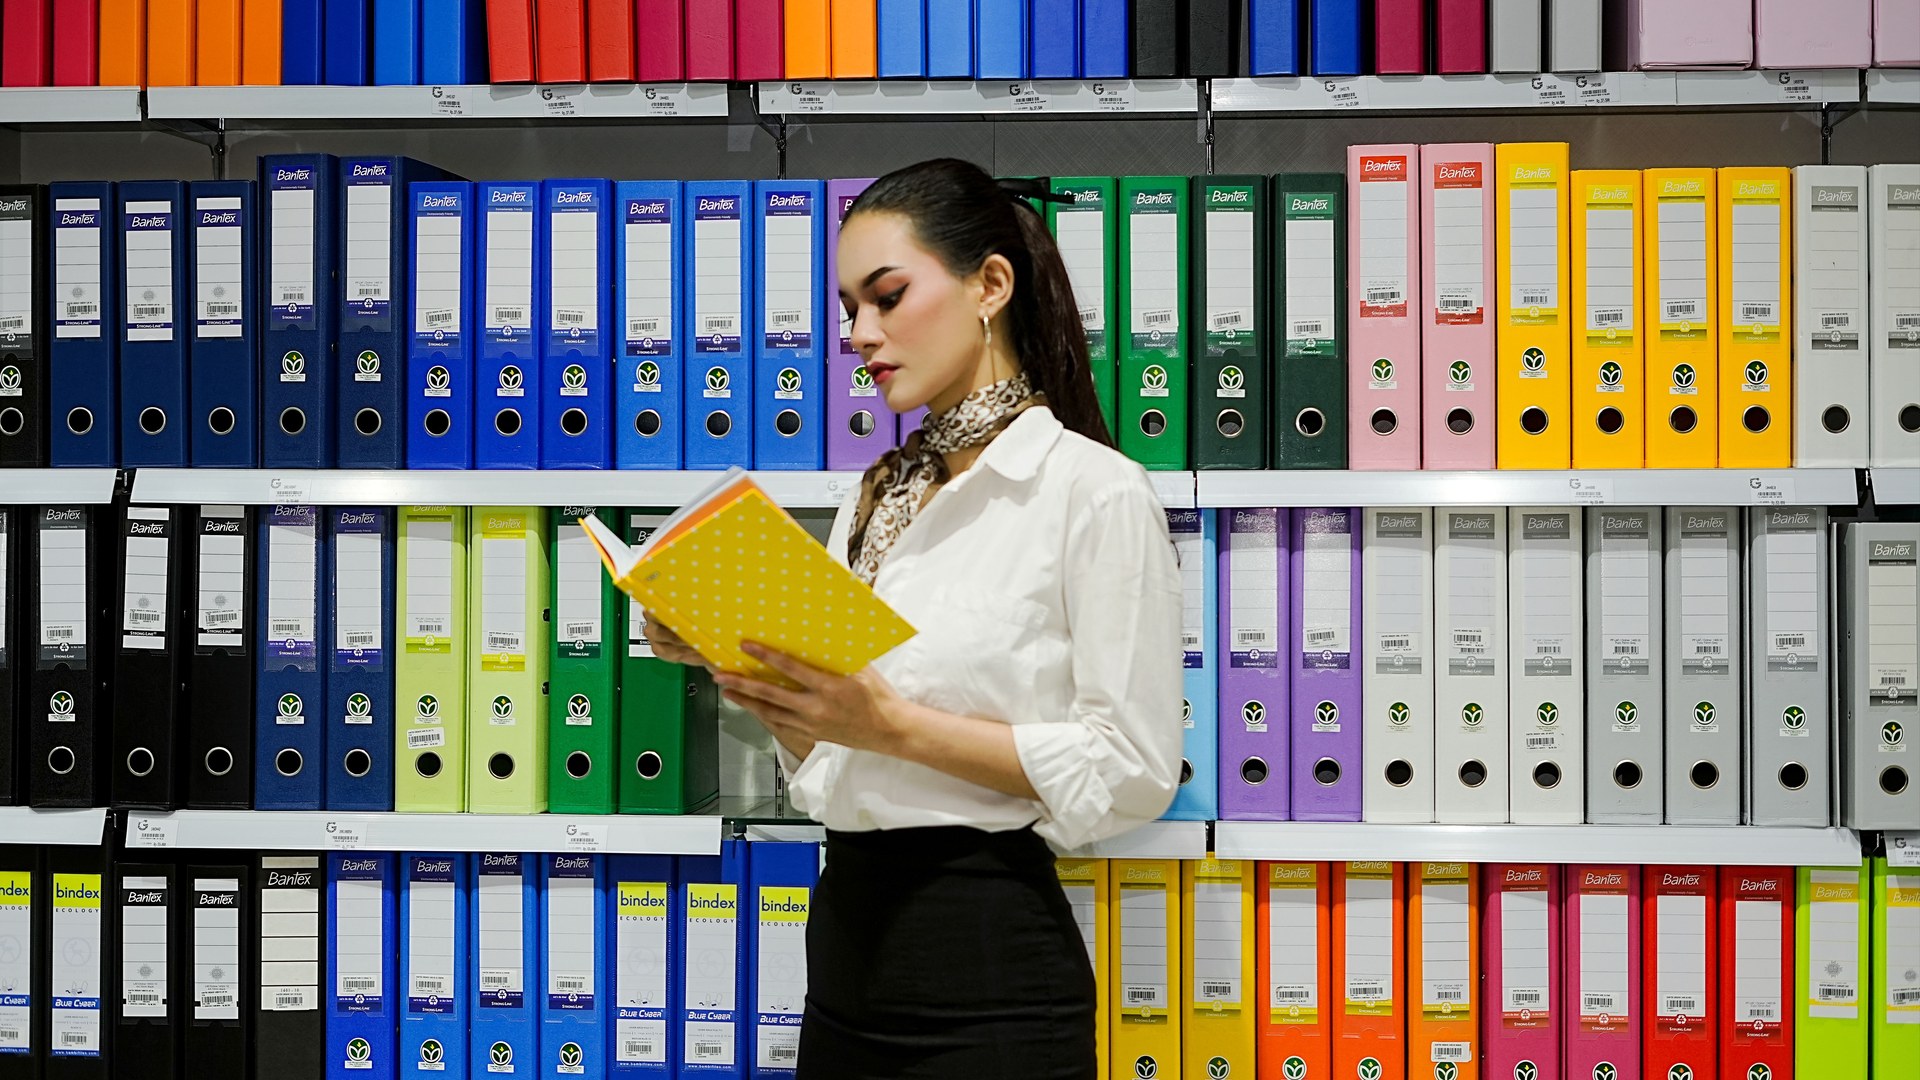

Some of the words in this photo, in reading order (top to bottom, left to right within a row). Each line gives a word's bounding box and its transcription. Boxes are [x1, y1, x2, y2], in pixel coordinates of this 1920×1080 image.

[353, 165, 387, 176] Bantex
[1365, 160, 1401, 171] Bantex
[277, 169, 310, 181] Bantex
[1440, 167, 1476, 179] Bantex
[1515, 167, 1551, 179] Bantex
[1664, 181, 1700, 193] Bantex
[1739, 183, 1774, 195] Bantex
[492, 191, 527, 202] Bantex
[558, 192, 593, 203] Bantex
[1137, 193, 1172, 205] Bantex
[1212, 191, 1248, 202] Bantex
[1593, 188, 1628, 200] Bantex
[1818, 190, 1852, 202] Bantex
[424, 196, 458, 207] Bantex
[699, 199, 734, 211] Bantex
[770, 195, 805, 206] Bantex
[1292, 199, 1328, 211] Bantex
[630, 203, 665, 214] Bantex
[62, 213, 95, 225] Bantex
[132, 216, 166, 227] Bantex
[203, 213, 236, 224] Bantex
[46, 509, 81, 520] Bantex
[274, 505, 310, 516] Bantex
[341, 513, 375, 524] Bantex
[488, 518, 521, 529] Bantex
[1236, 512, 1271, 523] Bantex
[1310, 512, 1346, 524] Bantex
[1381, 516, 1416, 528] Bantex
[1454, 517, 1490, 529] Bantex
[1528, 517, 1563, 529] Bantex
[1607, 517, 1643, 529] Bantex
[1687, 516, 1723, 528] Bantex
[1772, 512, 1809, 524] Bantex
[131, 522, 164, 534] Bantex
[205, 521, 240, 532] Bantex
[1874, 543, 1910, 556] Bantex
[342, 860, 376, 871] Bantex
[484, 854, 517, 866] Bantex
[555, 857, 590, 868] Bantex
[417, 861, 451, 872] Bantex
[1200, 862, 1235, 874] Bantex
[1427, 863, 1462, 875] Bantex
[268, 872, 311, 886] Bantex
[1275, 867, 1311, 879] Bantex
[1506, 870, 1541, 881] Bantex
[1585, 873, 1622, 885] Bantex
[1663, 874, 1700, 886] Bantex
[1741, 879, 1777, 891] Bantex
[56, 883, 99, 898] bindex
[1816, 887, 1853, 899] Bantex
[128, 892, 162, 903] Bantex
[200, 894, 234, 905] Bantex
[620, 890, 665, 907] bindex
[690, 892, 735, 909] bindex
[762, 896, 807, 913] bindex
